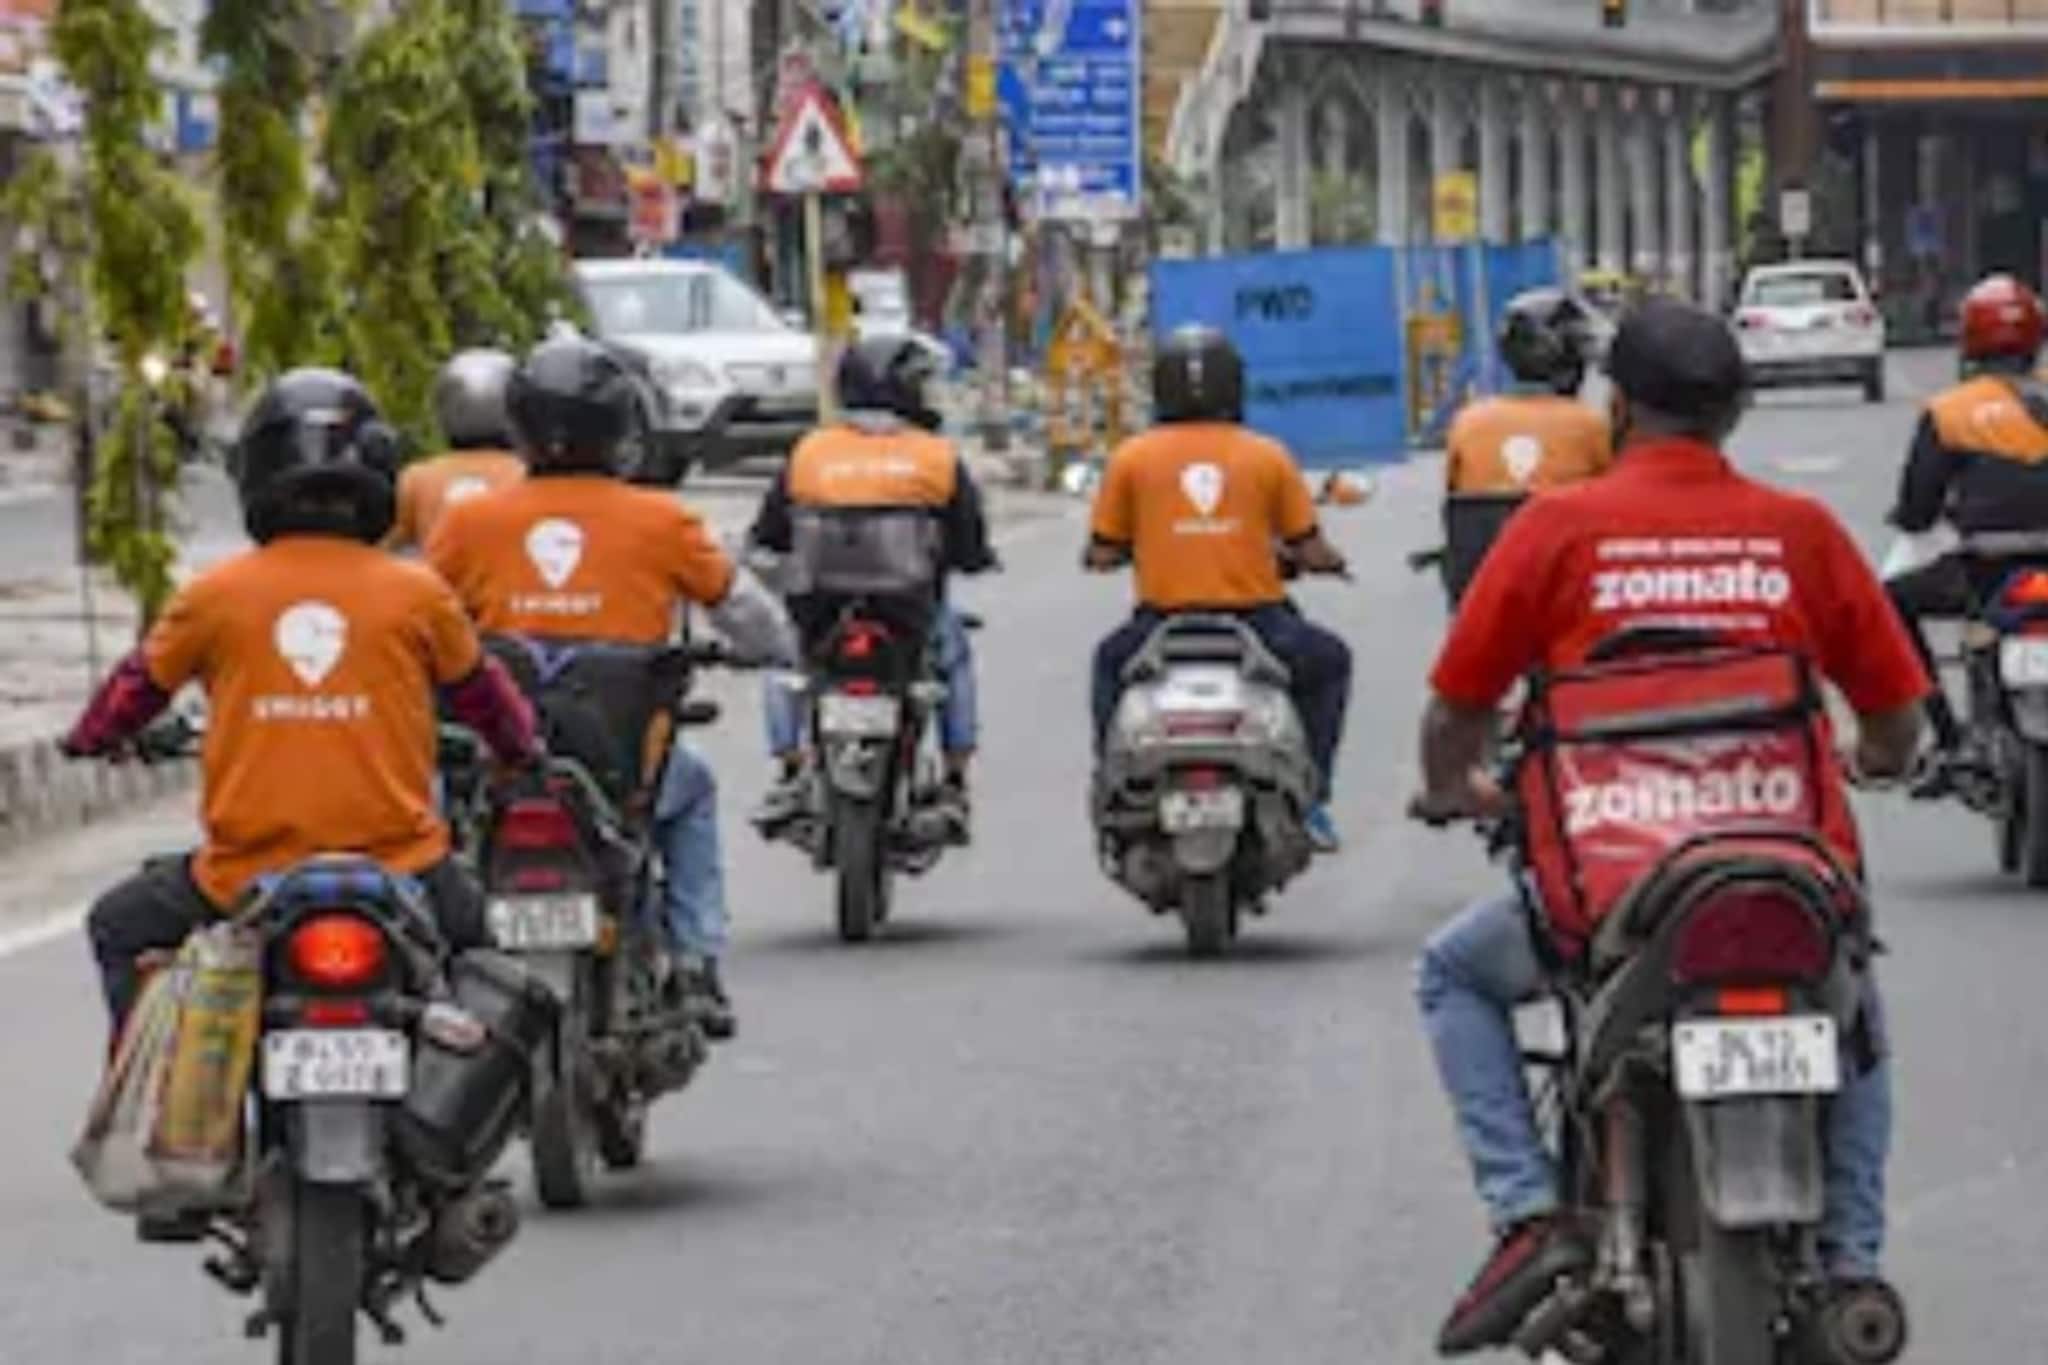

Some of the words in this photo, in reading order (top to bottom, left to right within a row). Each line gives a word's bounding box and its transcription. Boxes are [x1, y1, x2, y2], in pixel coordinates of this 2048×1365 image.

[1235, 284, 1313, 320] PWD
[1592, 558, 1789, 609] zomato
[1563, 757, 1801, 833] zomato
